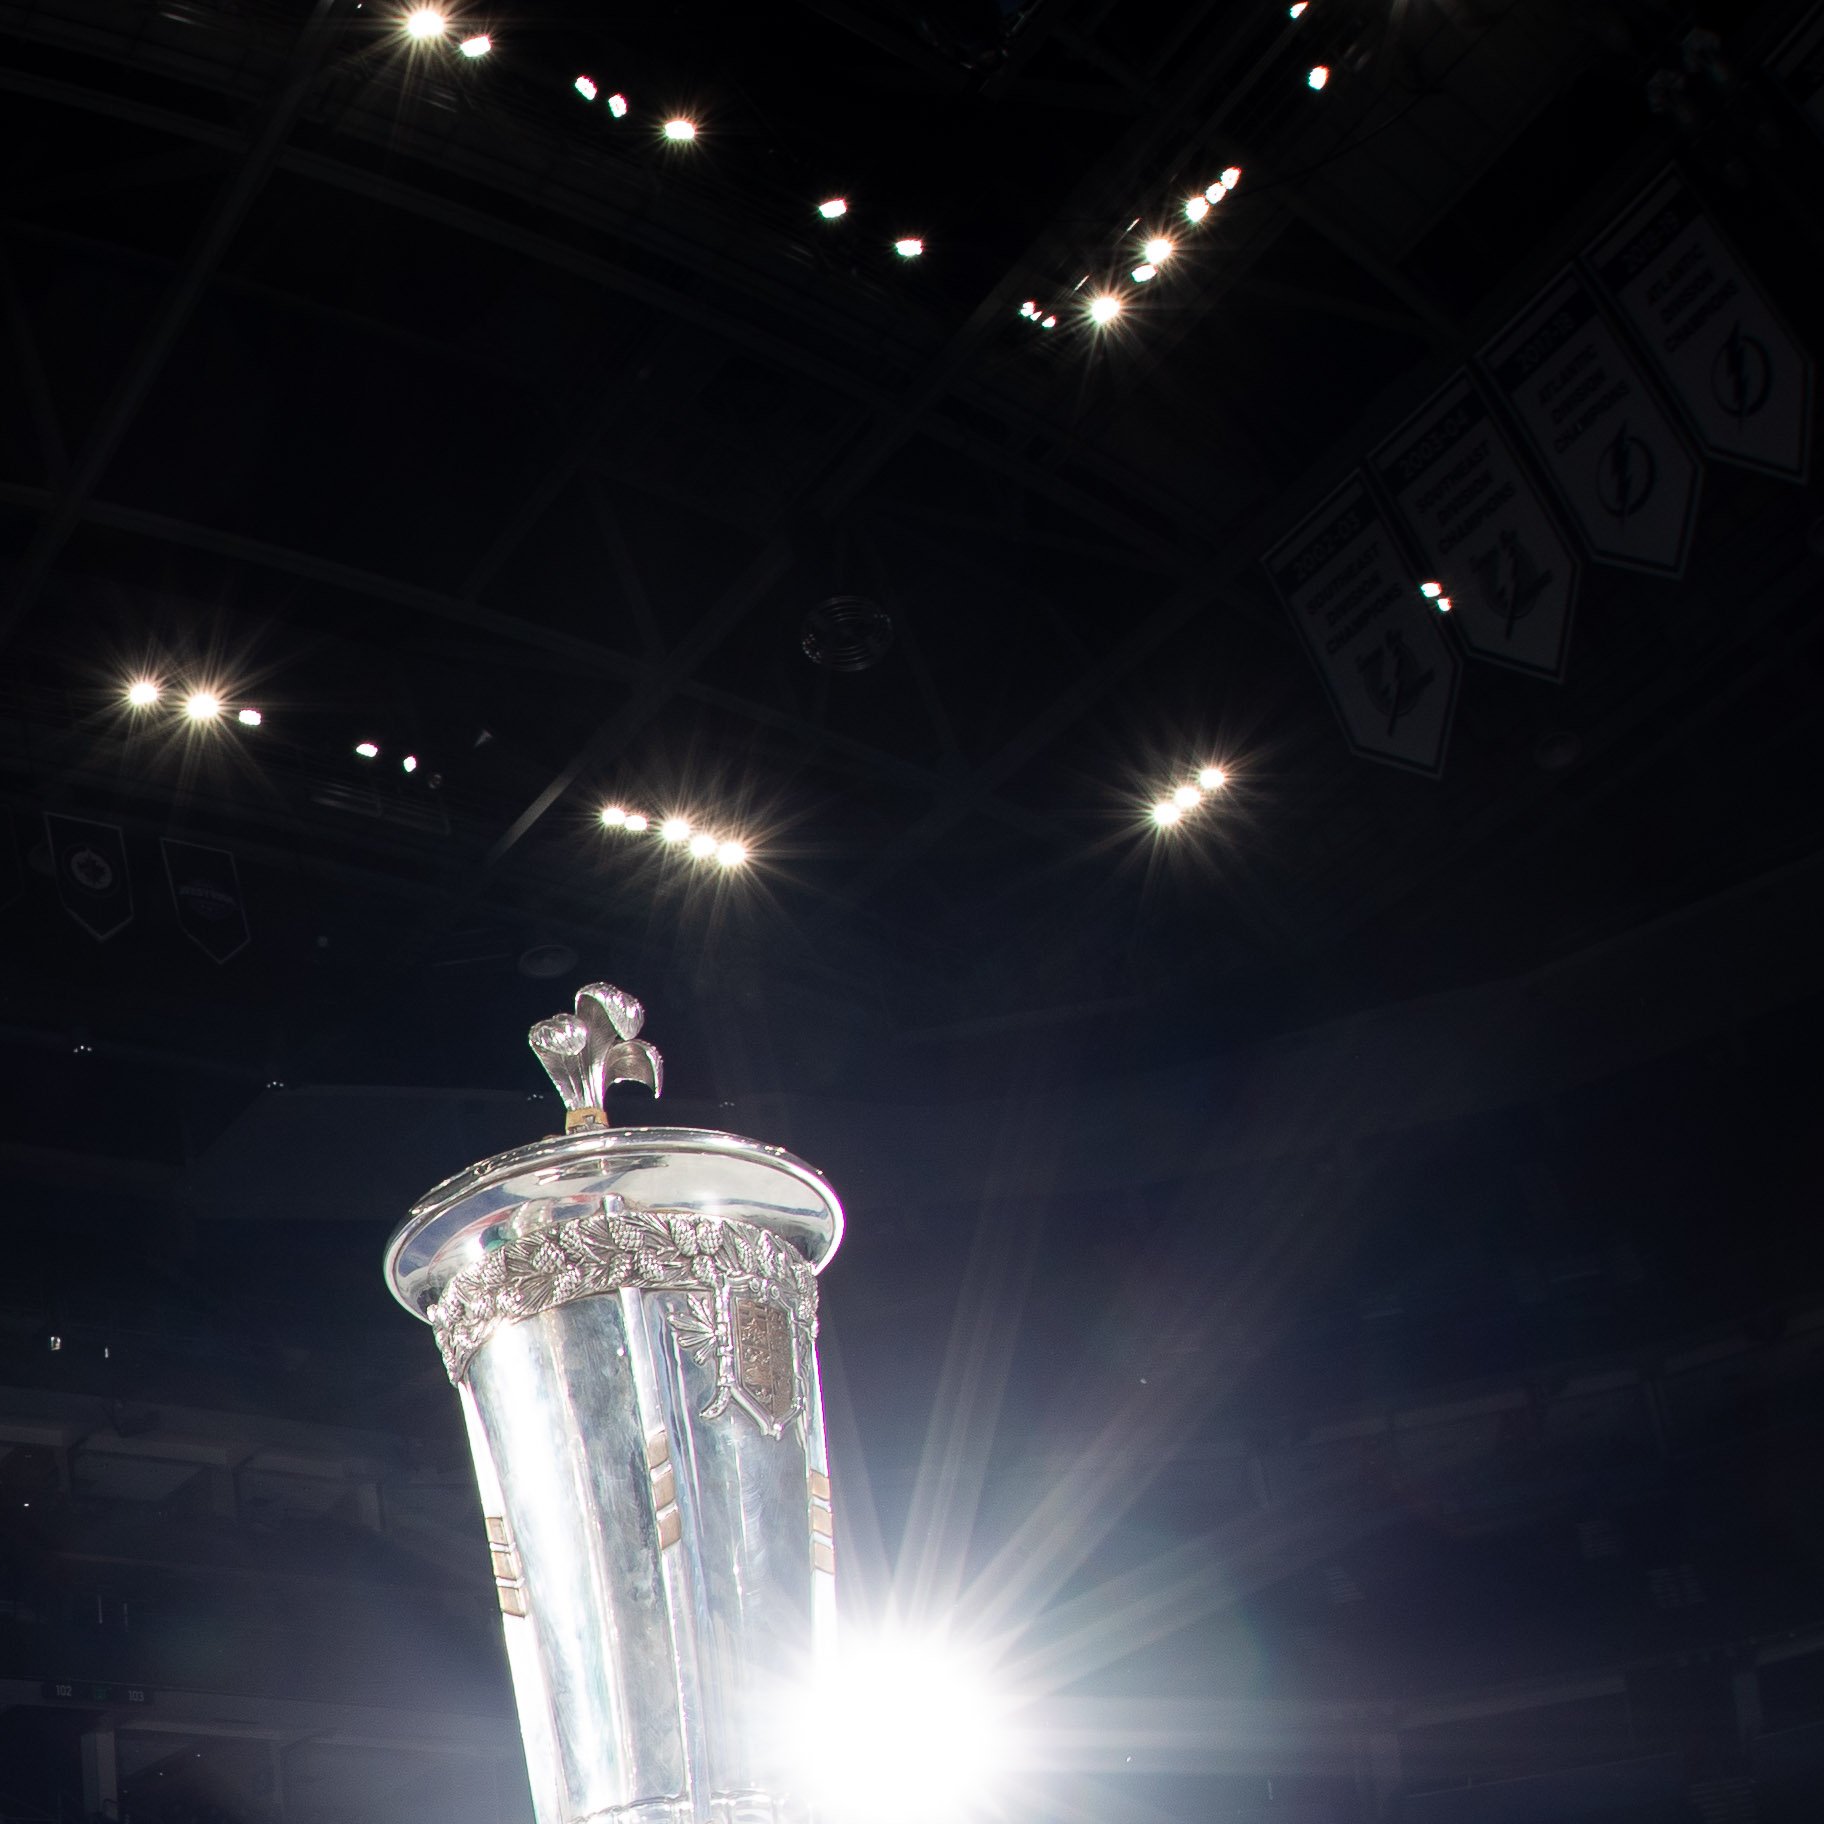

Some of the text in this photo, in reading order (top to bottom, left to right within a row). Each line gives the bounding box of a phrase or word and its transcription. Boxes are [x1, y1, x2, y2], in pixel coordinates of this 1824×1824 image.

[1662, 268, 1713, 324] DIVISION
[1664, 280, 1738, 352] CHAMPIONS
[1539, 343, 1597, 405] ATLANTIC
[1552, 366, 1605, 424] DIVISION
[1401, 406, 1472, 479] 2003-04
[1555, 380, 1629, 454] CHAMPIONS
[1416, 440, 1489, 514] SOUTHEAST
[1437, 470, 1492, 526] DIVISION
[1293, 513, 1361, 579] 2002-03
[1439, 481, 1515, 554] CHAMPIONS
[1306, 542, 1379, 615] SOUTHEAST
[1326, 571, 1381, 626] DIVISION
[1326, 583, 1401, 654] CHAMPIONS
[55, 1684, 73, 1698] 102
[127, 1689, 145, 1703] 103
